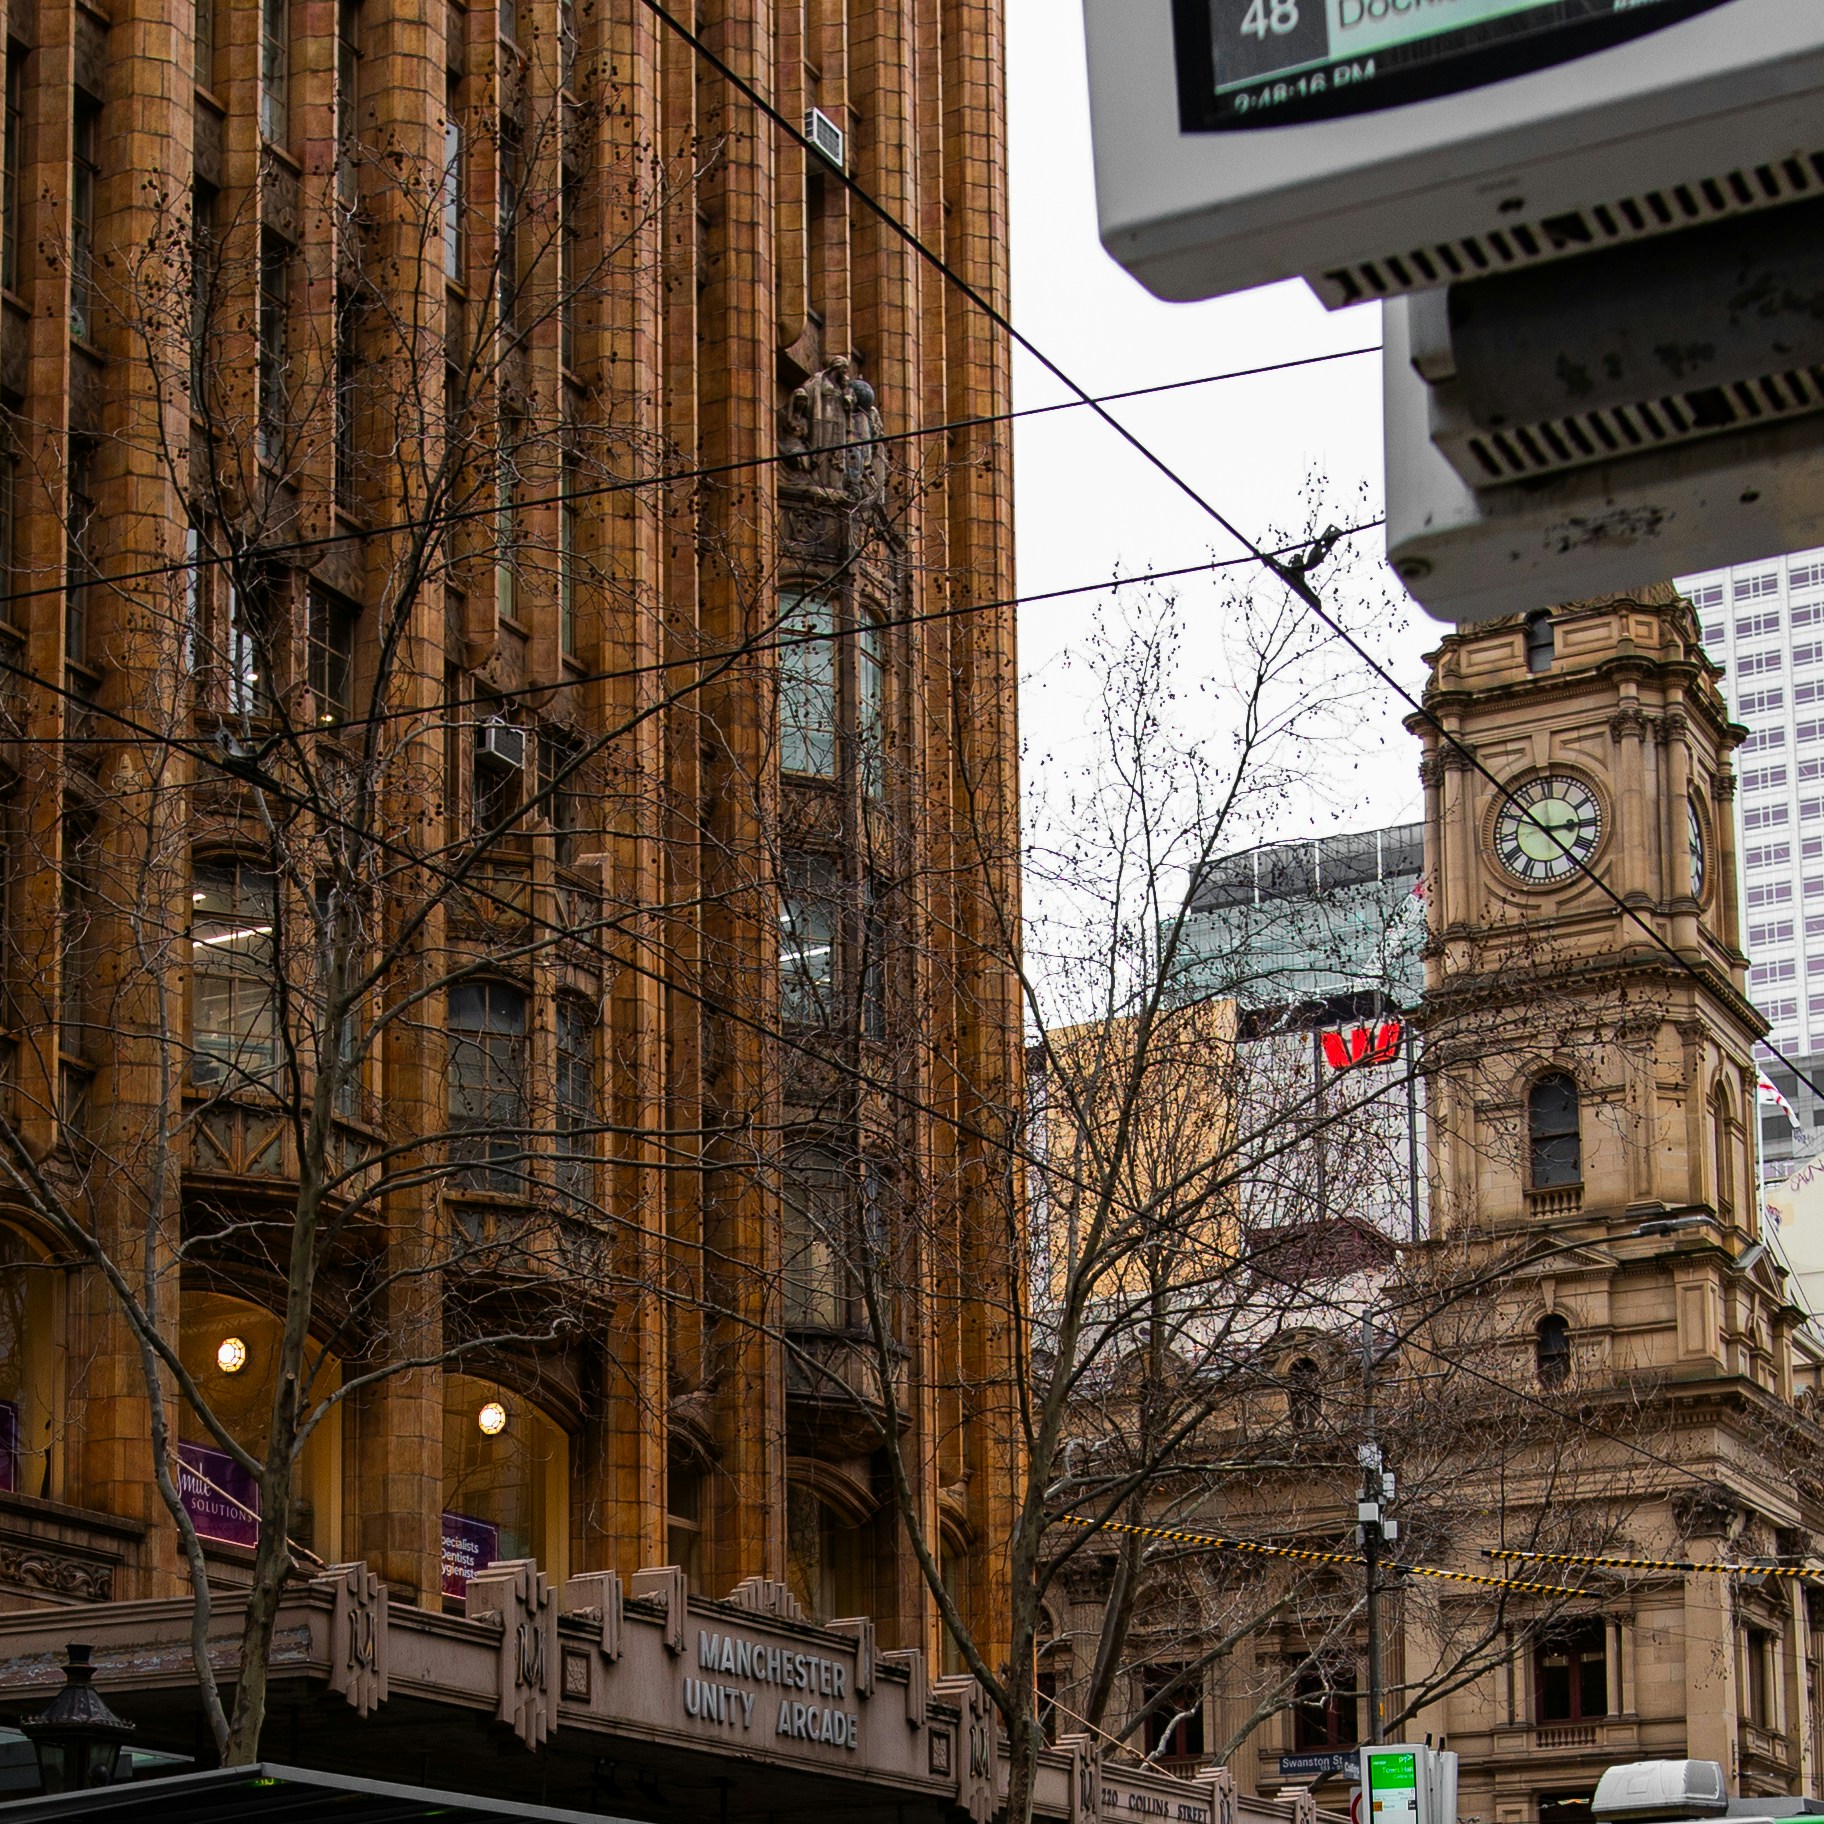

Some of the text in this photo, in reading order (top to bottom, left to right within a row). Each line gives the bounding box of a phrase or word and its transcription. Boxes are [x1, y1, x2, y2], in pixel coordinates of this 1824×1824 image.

[1240, 0, 1299, 41] 48
[191, 1498, 253, 1523] SOLUTIONS
[441, 1535, 479, 1554] pecialists
[441, 1562, 478, 1579] ygienists
[699, 1630, 845, 1699] MANCHESTER
[684, 1677, 858, 1750] UNITY ARCADE
[1282, 1757, 1330, 1769] Swanston
[1332, 1755, 1343, 1765] St
[1101, 1788, 1208, 1824] 220 COLLINS STREET
